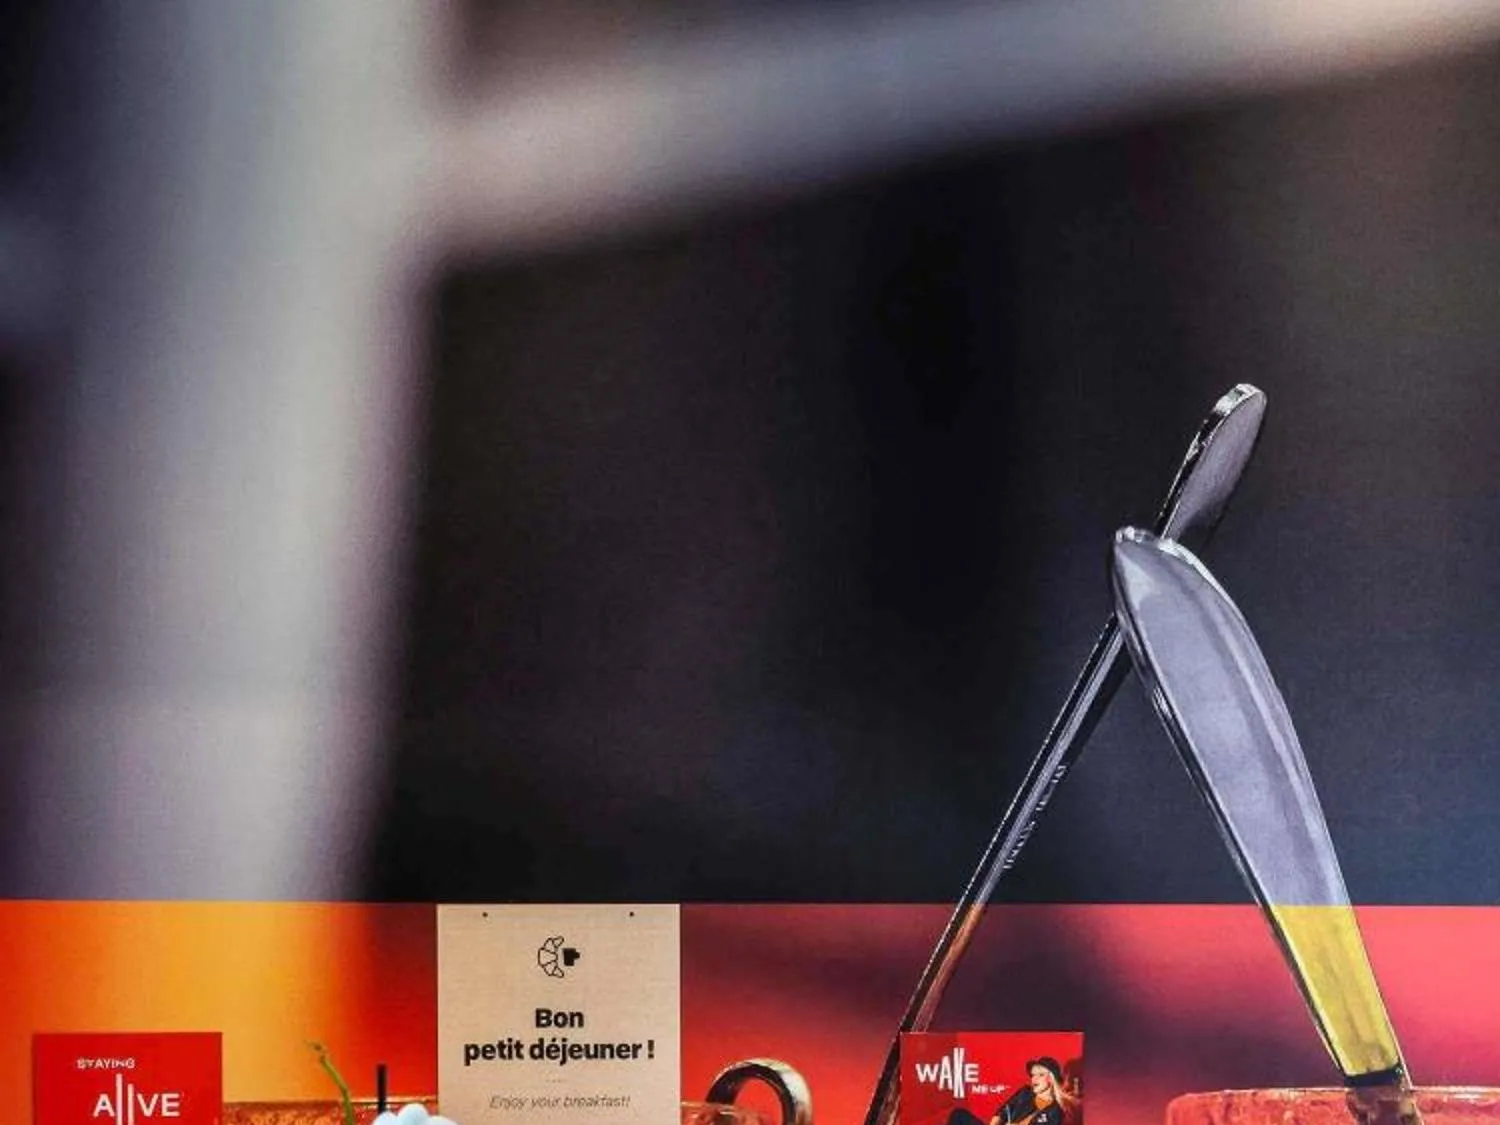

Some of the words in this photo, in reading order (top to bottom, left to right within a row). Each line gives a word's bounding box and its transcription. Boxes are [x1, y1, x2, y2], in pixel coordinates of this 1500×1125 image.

[535, 1008, 584, 1028] Bon
[463, 1038, 524, 1066] petit
[529, 1037, 642, 1066] déjeuner
[647, 1039, 655, 1059] !
[77, 1057, 136, 1070] STAYING
[915, 1047, 980, 1099] WAKE
[489, 1095, 526, 1110] Enjoy
[532, 1097, 559, 1110] your
